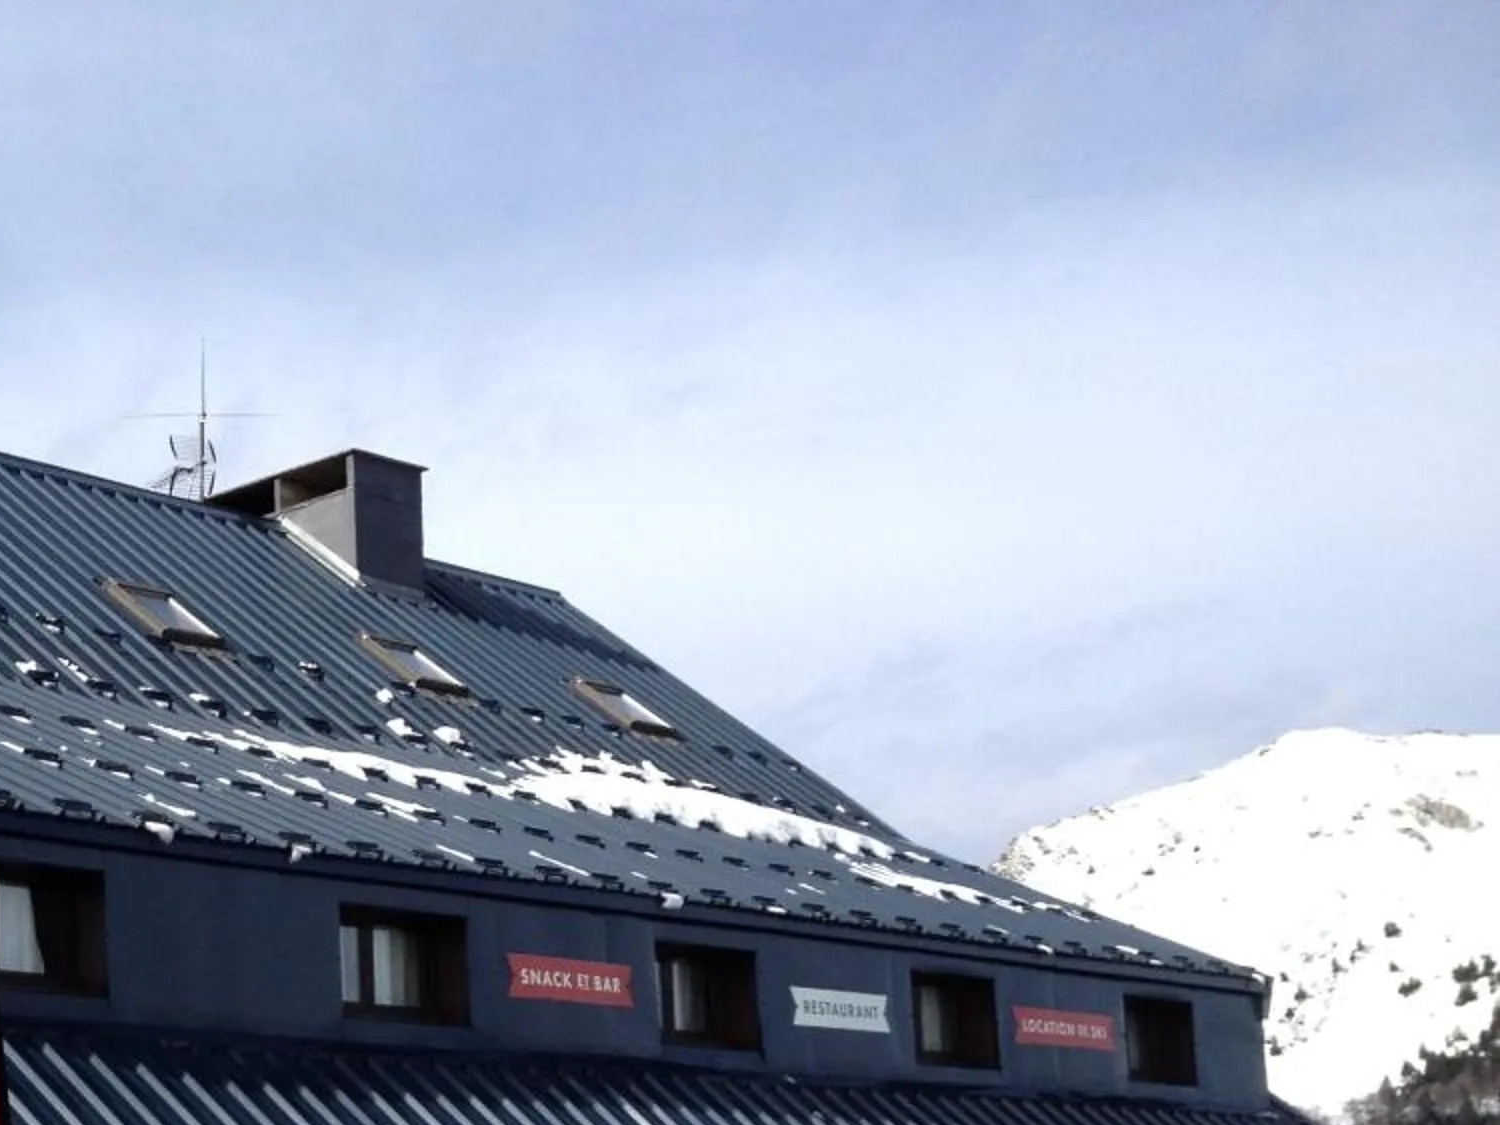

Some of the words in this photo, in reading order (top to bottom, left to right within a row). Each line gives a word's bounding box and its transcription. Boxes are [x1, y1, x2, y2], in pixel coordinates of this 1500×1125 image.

[520, 967, 573, 989] SNACK
[594, 976, 621, 993] BAR
[803, 999, 879, 1020] RESTAURANT
